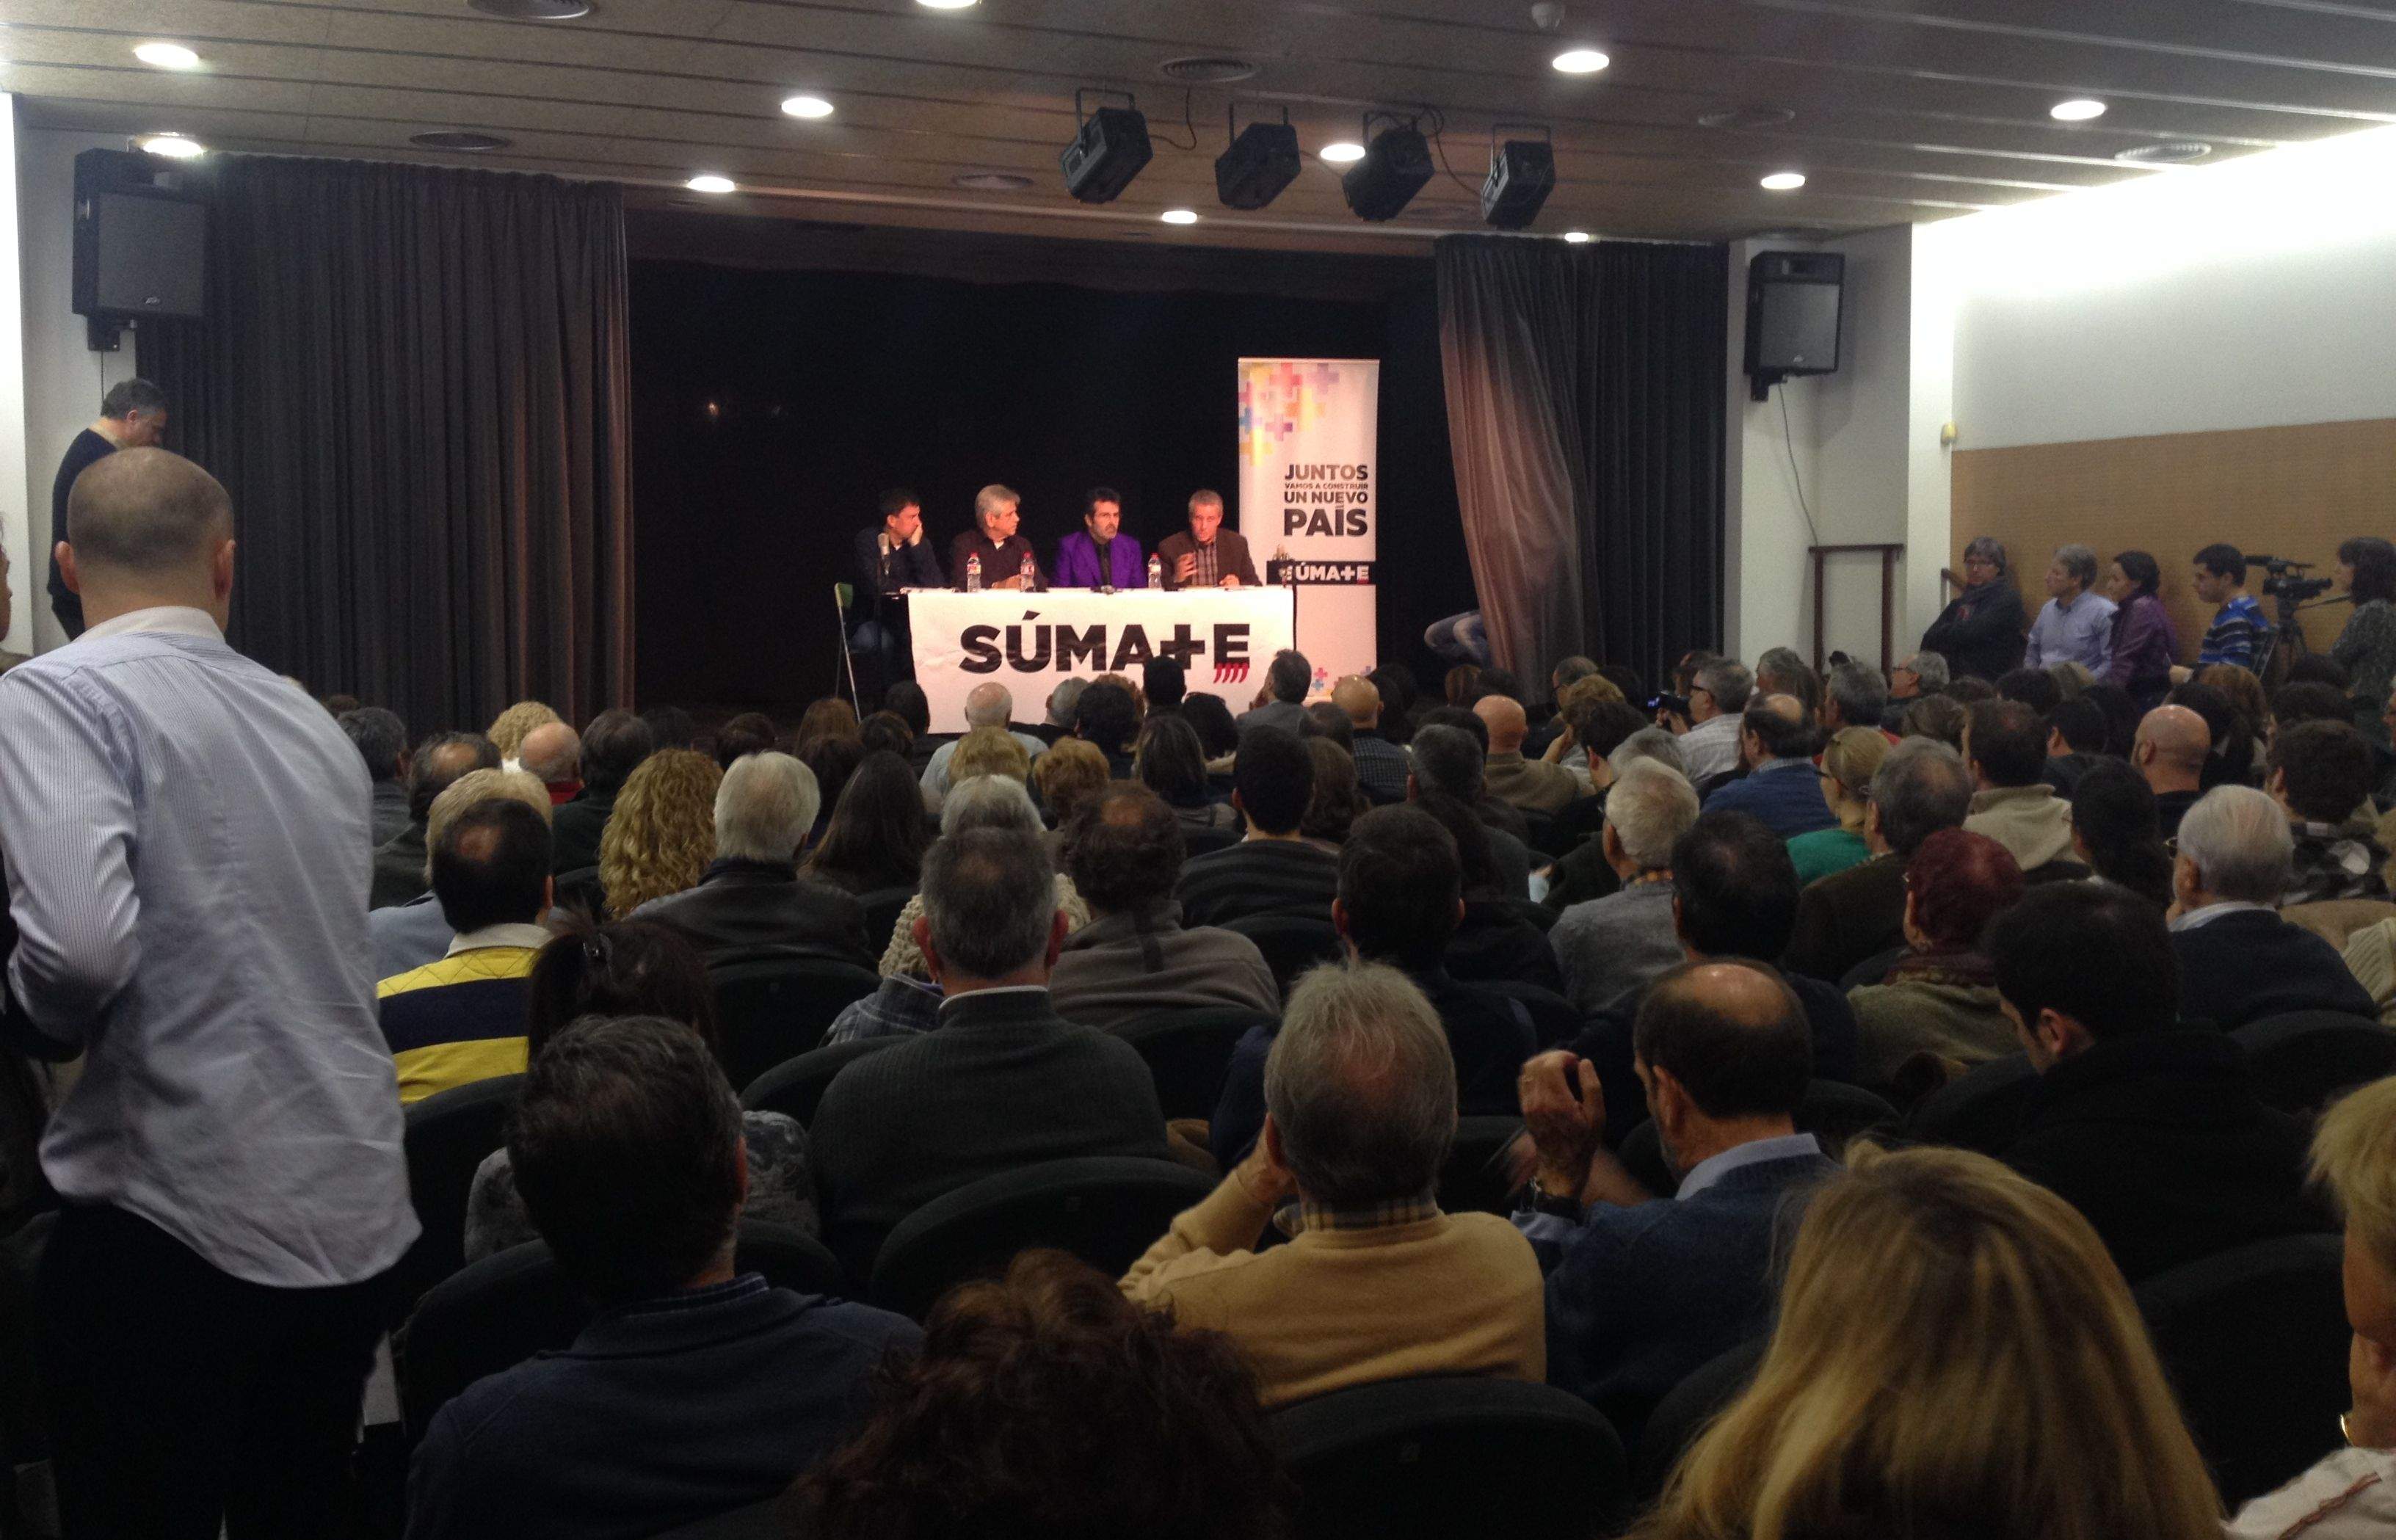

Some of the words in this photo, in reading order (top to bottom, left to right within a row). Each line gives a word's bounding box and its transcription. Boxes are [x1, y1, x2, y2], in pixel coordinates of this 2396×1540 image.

[1285, 464, 1368, 481] JUNTOS
[1284, 491, 1307, 504] UN
[1311, 491, 1368, 504] NUEVO
[1283, 504, 1368, 537] PAÍS
